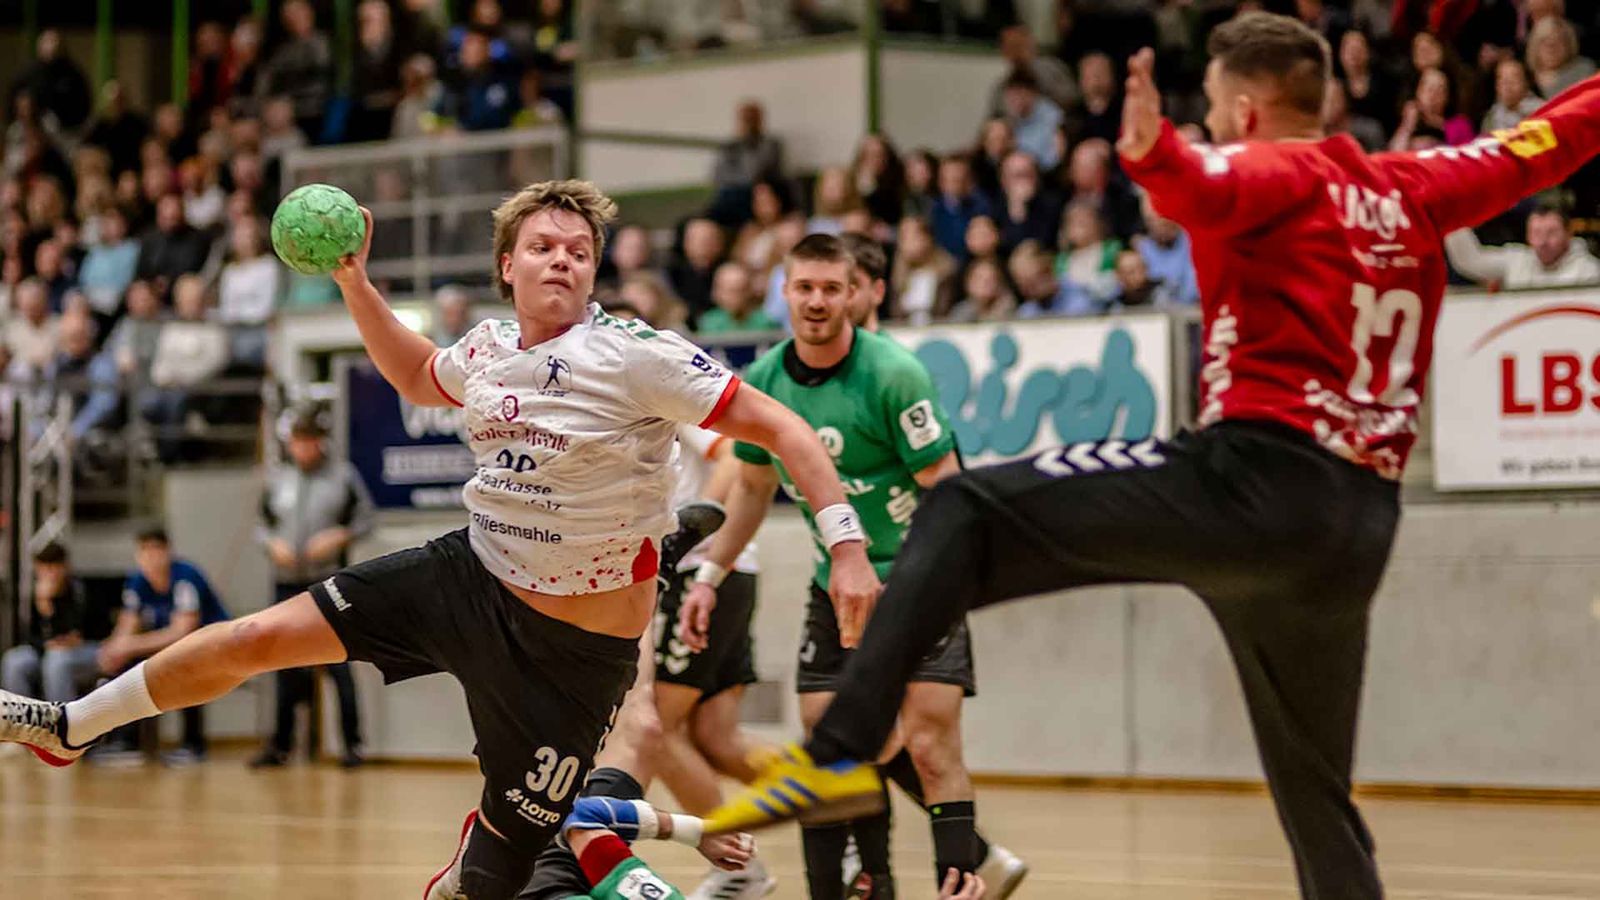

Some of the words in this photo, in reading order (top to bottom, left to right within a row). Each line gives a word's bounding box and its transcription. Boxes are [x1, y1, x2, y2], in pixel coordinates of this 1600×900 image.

[1499, 354, 1600, 416] LB
[525, 746, 580, 803] 30
[520, 798, 561, 824] LOTTO
